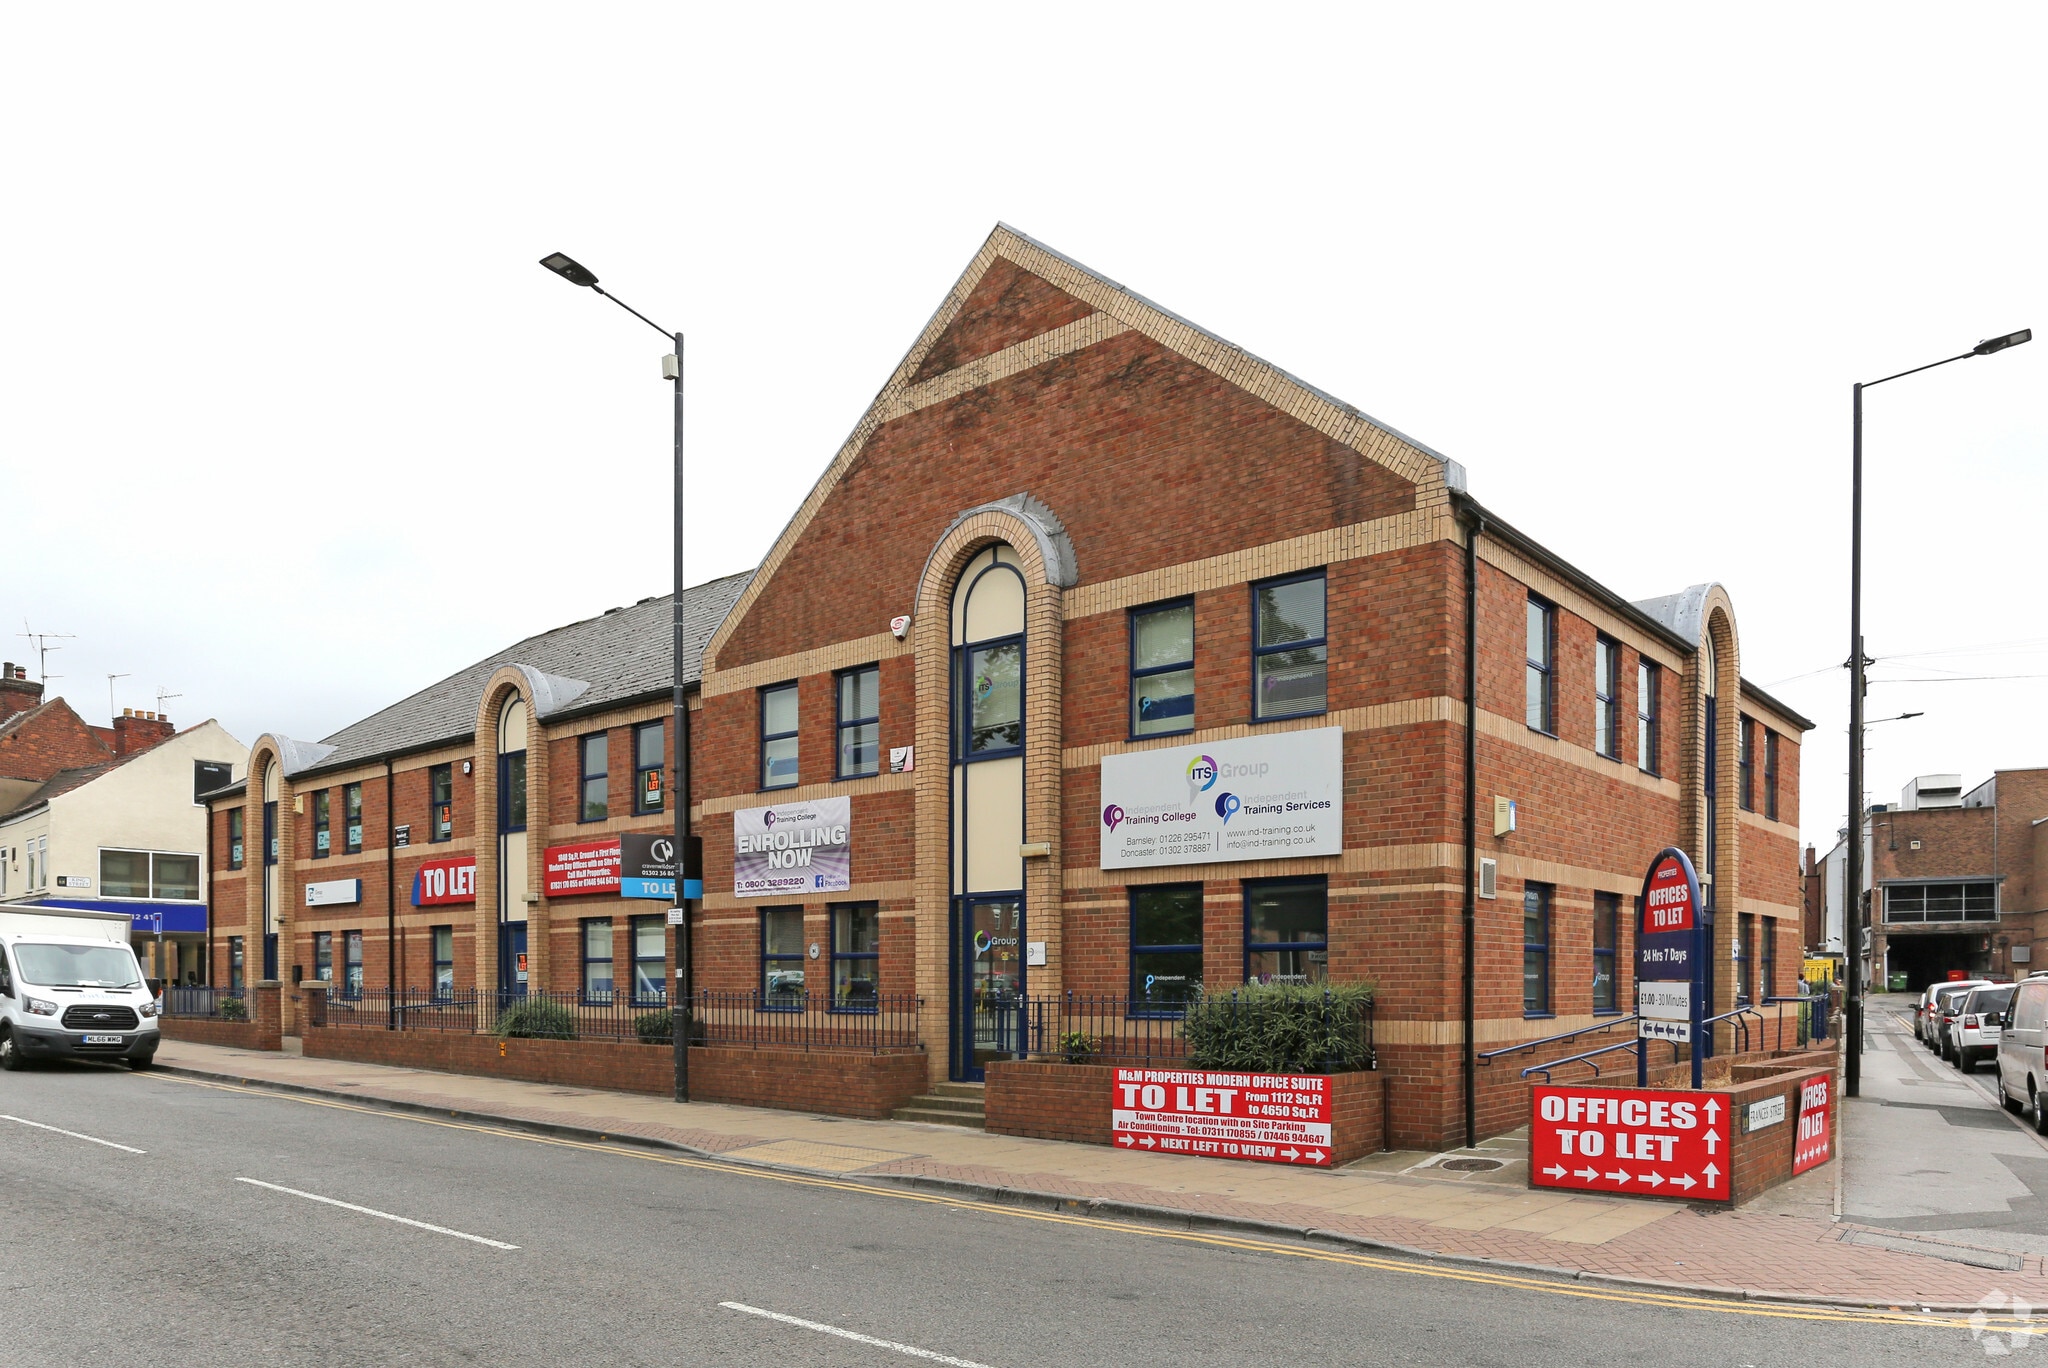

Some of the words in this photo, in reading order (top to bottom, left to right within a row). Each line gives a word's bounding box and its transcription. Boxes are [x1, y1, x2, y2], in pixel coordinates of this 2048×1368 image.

[650, 772, 657, 780] TO
[1192, 766, 1212, 780] ITS
[1220, 760, 1269, 779] Group
[648, 780, 658, 790] LET
[1244, 790, 1307, 805] Independent
[1125, 802, 1181, 815] Independent
[1244, 804, 1283, 816] Training
[1285, 799, 1331, 811] Services
[1125, 814, 1159, 826] Training
[1162, 810, 1197, 823] College
[1227, 824, 1315, 838] www.ind-training.co.uk
[738, 825, 846, 853] ENROLLING
[1126, 836, 1157, 846] Barnsley:
[1160, 834, 1182, 843] 01226
[1184, 832, 1210, 842] 295471
[1226, 836, 1315, 849] info@ind-training.co.uk
[580, 850, 595, 859] Ground
[768, 848, 812, 869] NOW
[1121, 848, 1157, 858] Doncaster:
[1159, 846, 1182, 855] 01302
[1183, 844, 1211, 854] 378887
[549, 864, 564, 872] Modern
[1657, 868, 1677, 879] PROPERTIES
[424, 868, 445, 897] TO
[449, 866, 476, 895] LET
[642, 882, 659, 894] TO
[662, 883, 675, 894] LE
[768, 878, 804, 886] 3289220
[1649, 884, 1688, 907] OFFICES
[1653, 910, 1666, 927] TO
[1667, 906, 1684, 926] LET
[991, 936, 1017, 946] Group
[1643, 951, 1651, 962] 24
[1652, 950, 1663, 961] Hrs
[1664, 950, 1669, 960] 7
[1670, 948, 1687, 964] Days
[1597, 972, 1609, 982] Group
[1641, 993, 1655, 1005] £1.00
[1658, 993, 1665, 1005] 30
[1666, 994, 1687, 1007] Minutes
[1119, 1070, 1142, 1082] M&M
[1145, 1071, 1204, 1085] PROPERTIES
[1206, 1074, 1250, 1087] MODERN
[1253, 1076, 1288, 1089] OFFICE
[1292, 1077, 1323, 1091] SUITE
[1119, 1084, 1166, 1109] TO
[1176, 1086, 1238, 1114] LET
[1245, 1091, 1269, 1102] From
[1271, 1092, 1293, 1103] 1112
[1296, 1093, 1323, 1105] Sq.Ft
[1249, 1104, 1259, 1114] to
[1261, 1105, 1289, 1116] 4650
[1292, 1107, 1319, 1119] Sq.Ft
[1540, 1095, 1698, 1129] OFFICES
[1750, 1107, 1768, 1123] FRANCES
[1770, 1102, 1784, 1118] STREET
[1135, 1112, 1155, 1121] Town
[1157, 1113, 1183, 1123] Centre
[1185, 1114, 1219, 1125] location
[1220, 1117, 1239, 1127] with
[1240, 1120, 1251, 1128] on
[1252, 1119, 1269, 1129] Site
[1272, 1121, 1305, 1132] Parking
[1801, 1116, 1810, 1141] TO
[1812, 1112, 1824, 1137] LET
[1118, 1121, 1128, 1129] Air
[1130, 1122, 1180, 1133] Conditioning
[1186, 1125, 1200, 1135] Tel:
[1202, 1126, 1225, 1137] 07311
[1226, 1128, 1256, 1138] 170855
[1264, 1131, 1290, 1142] 07446
[1292, 1132, 1325, 1144] 944647
[1160, 1137, 1190, 1150] NEXT
[1193, 1140, 1219, 1153] LEFT
[1222, 1142, 1238, 1154] TO
[1240, 1143, 1276, 1158] VIEW
[1556, 1128, 1605, 1157] TO
[1615, 1132, 1679, 1162] LET
